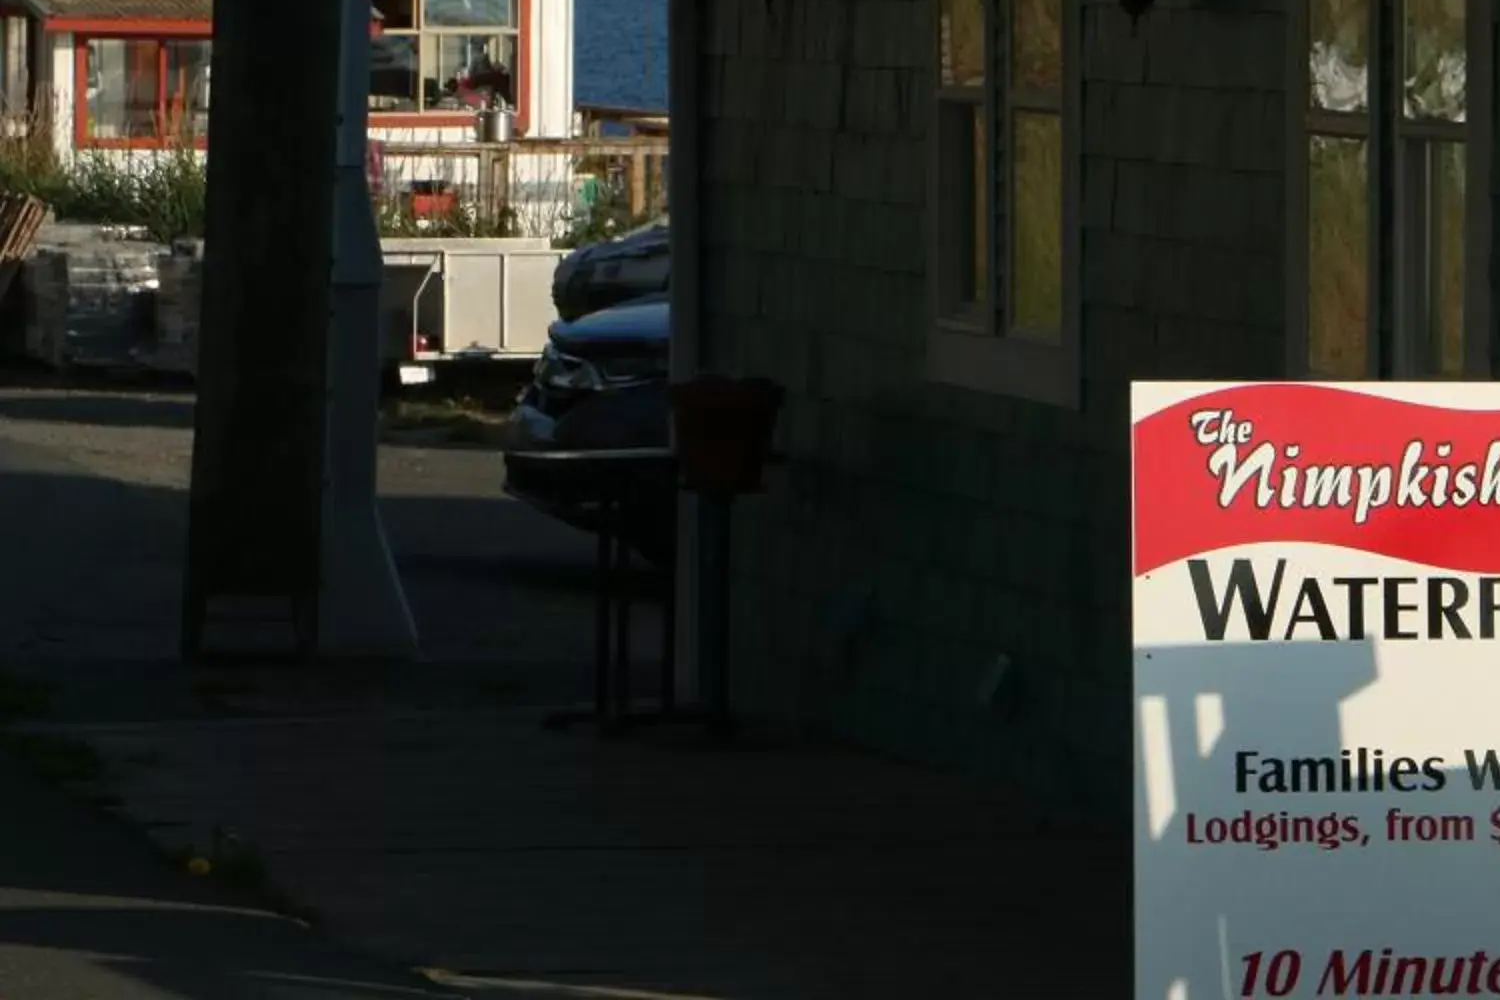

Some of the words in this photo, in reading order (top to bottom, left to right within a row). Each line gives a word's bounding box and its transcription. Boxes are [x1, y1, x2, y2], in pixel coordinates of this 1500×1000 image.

[1188, 408, 1254, 445] The
[1234, 748, 1447, 794] Families
[1186, 810, 1371, 851] Lodgings,
[1386, 808, 1475, 843] from
[1239, 949, 1302, 998] 10
